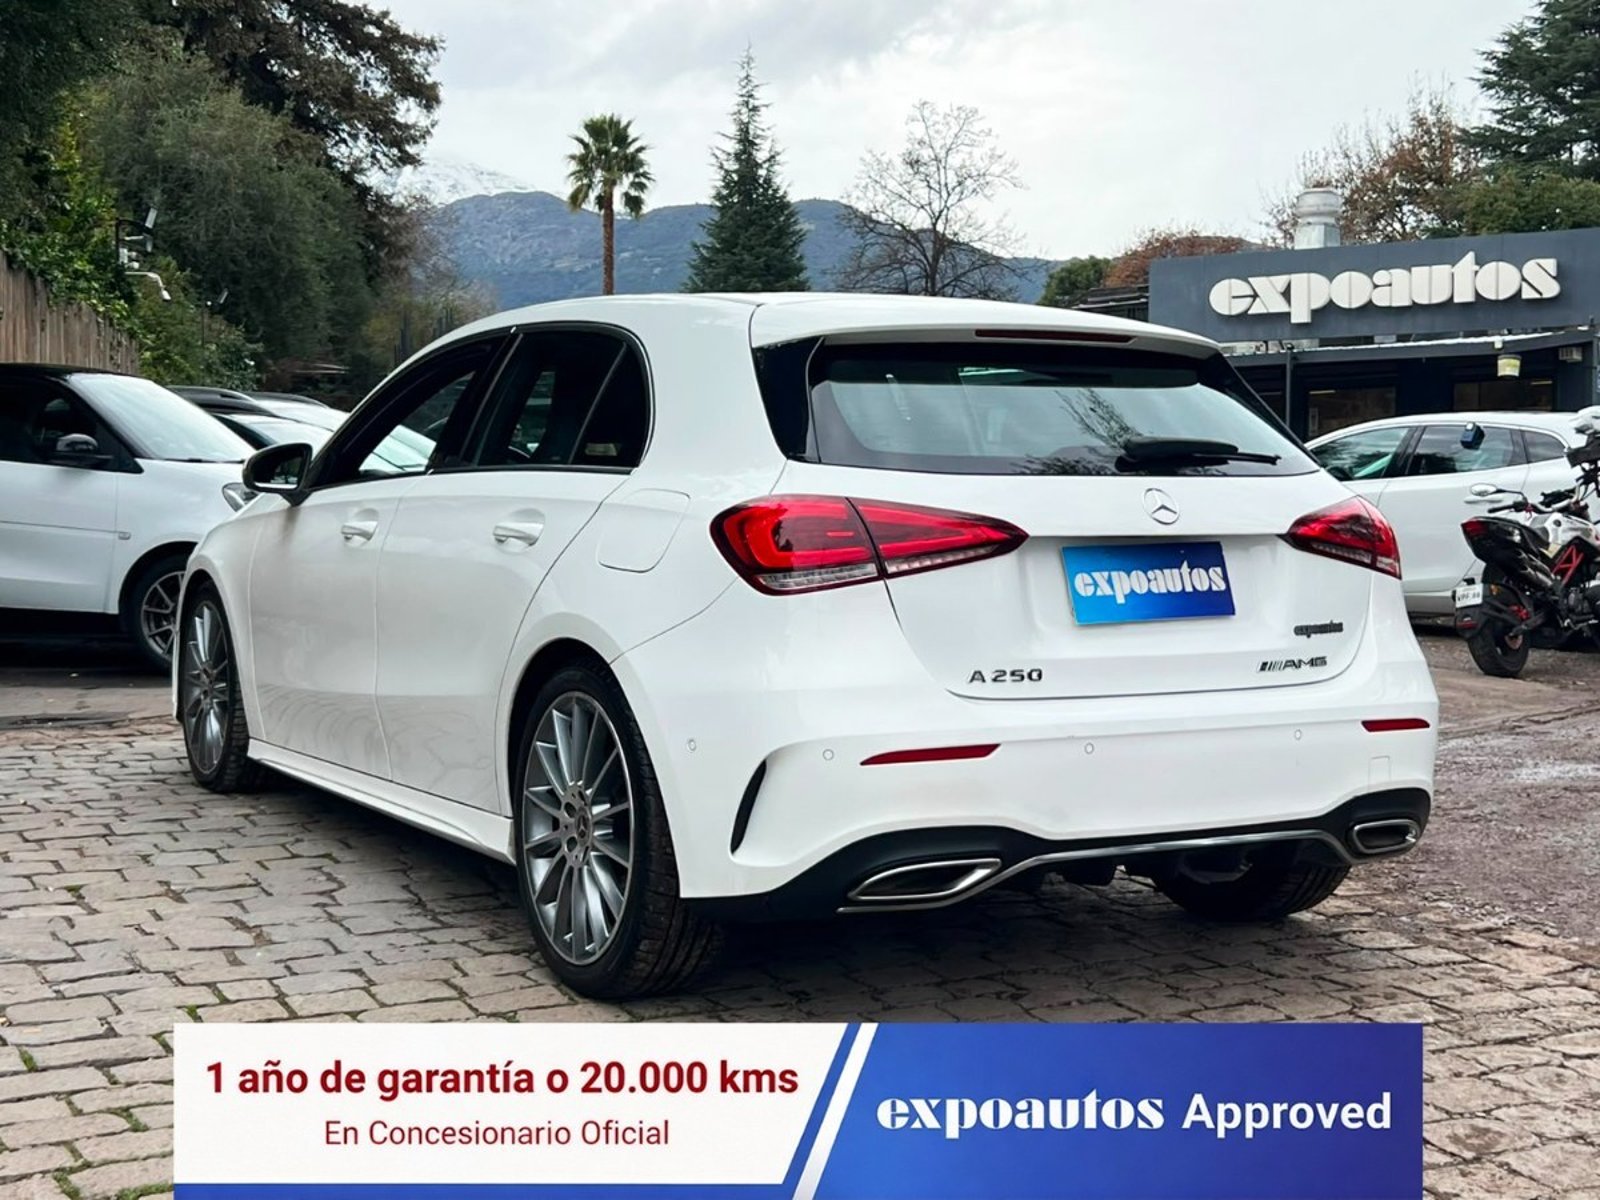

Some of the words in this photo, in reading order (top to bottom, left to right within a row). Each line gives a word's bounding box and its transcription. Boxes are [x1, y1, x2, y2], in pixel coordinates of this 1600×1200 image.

[1209, 251, 1561, 323] expoautos
[1074, 560, 1226, 604] expoautos
[969, 670, 986, 683] A
[991, 668, 1043, 683] 250
